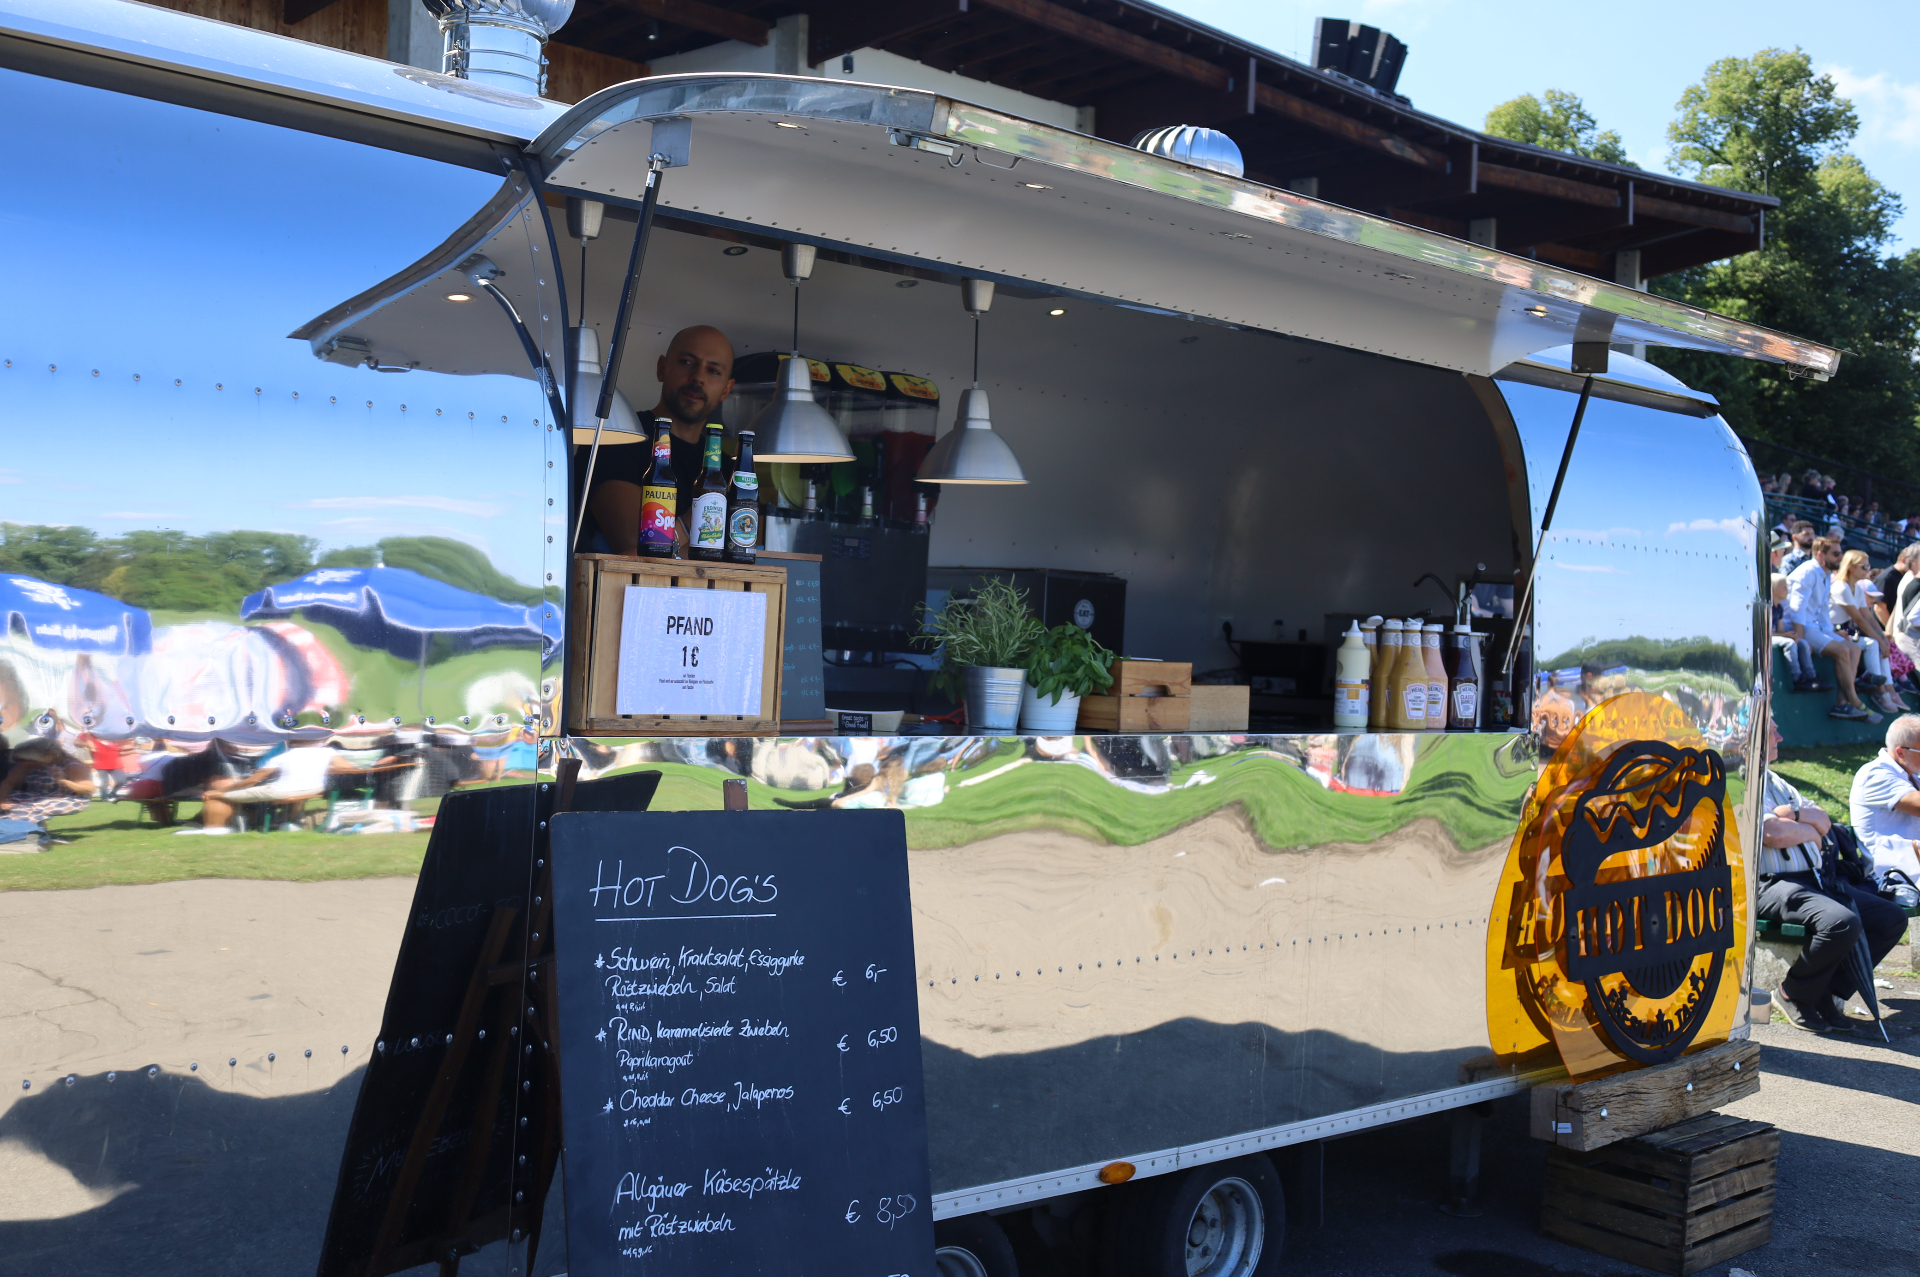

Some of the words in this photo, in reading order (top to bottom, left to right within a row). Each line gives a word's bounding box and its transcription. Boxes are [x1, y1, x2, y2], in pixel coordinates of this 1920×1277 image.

[654, 446, 671, 457] Spez
[645, 490, 677, 501] PAULAN
[655, 509, 676, 530] Spe
[666, 615, 714, 636] PFAND
[1410, 686, 1425, 694] HEINZ
[589, 859, 666, 908] HOT
[1576, 895, 1649, 958] HOT
[1663, 886, 1726, 944] DOG
[867, 1026, 898, 1048] 6,50
[619, 1088, 676, 1111] Cheddar
[872, 1086, 904, 1111] 6,50
[876, 1193, 917, 1230] 8,50
[618, 1222, 644, 1241] mit
